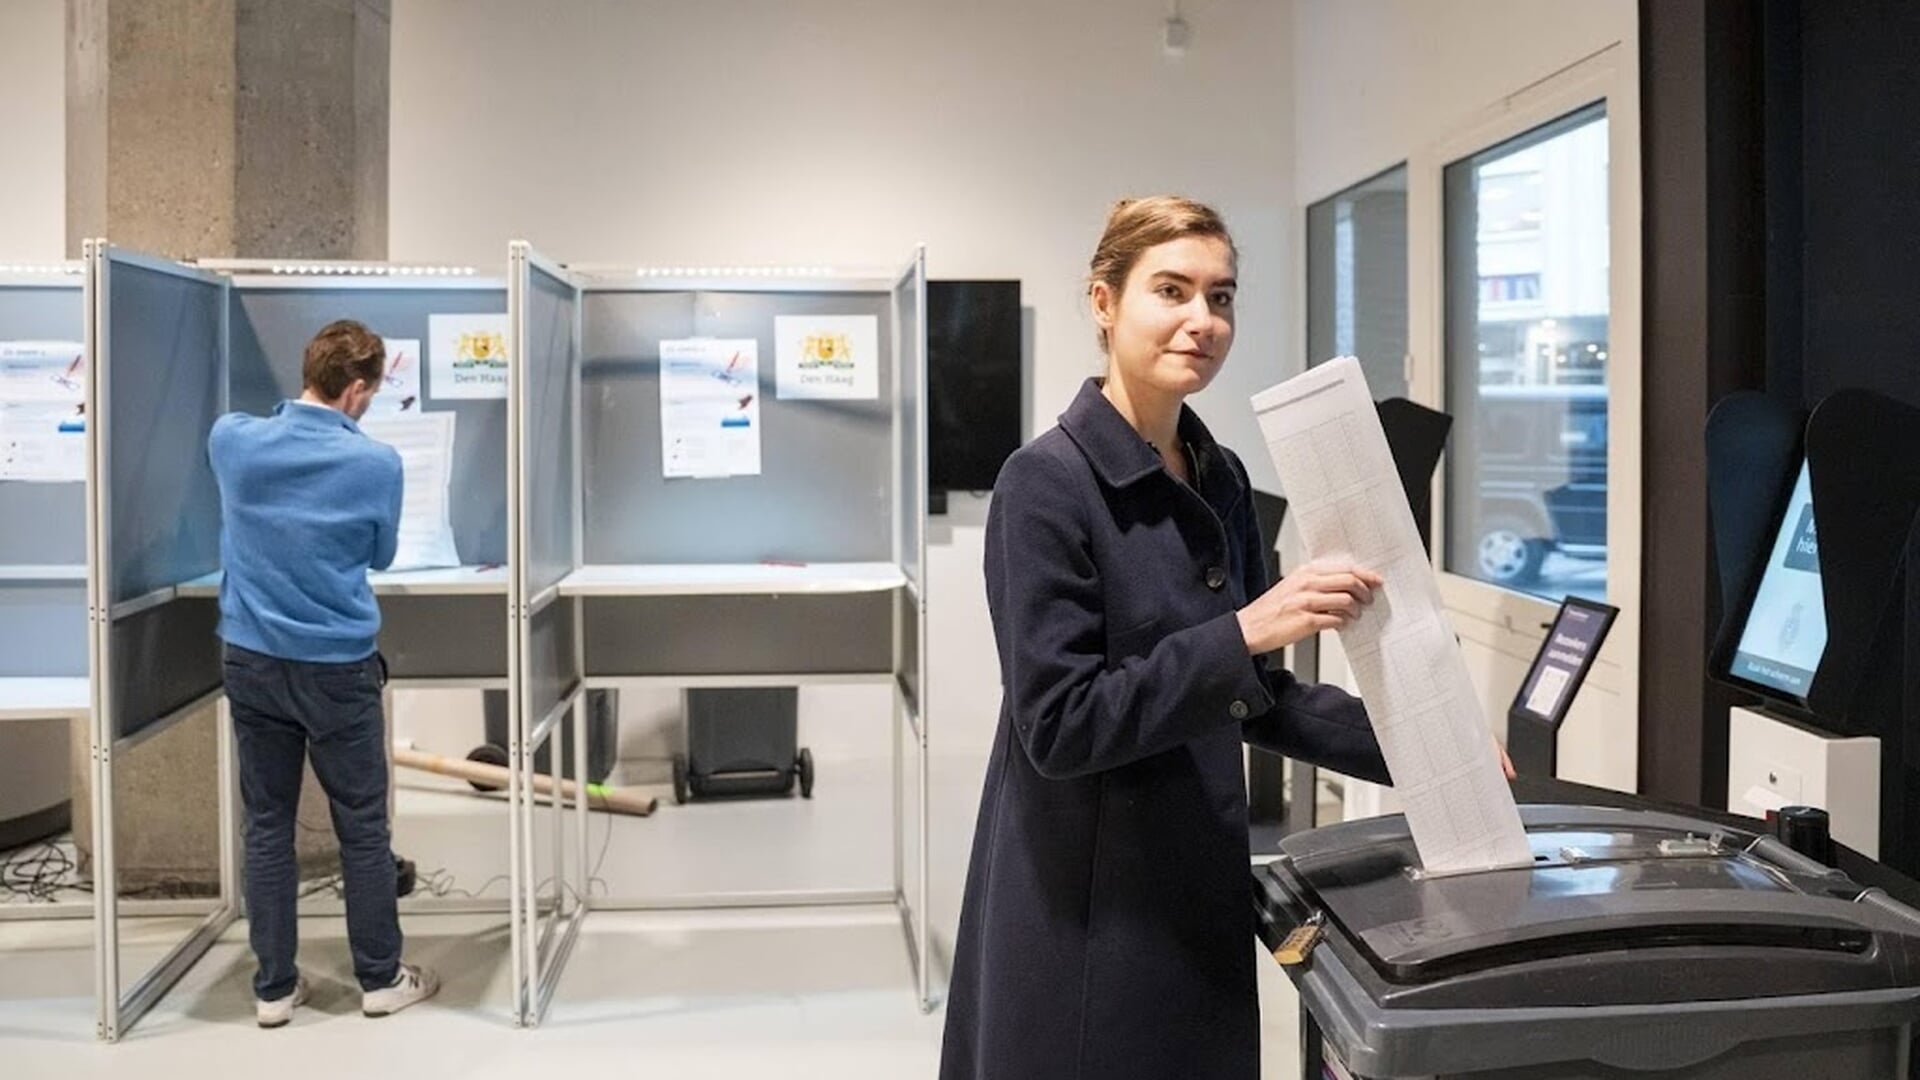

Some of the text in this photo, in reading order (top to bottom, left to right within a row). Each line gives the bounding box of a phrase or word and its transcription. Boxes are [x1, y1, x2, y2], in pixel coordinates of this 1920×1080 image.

[454, 374, 477, 384] Den
[800, 374, 854, 387] Den Haag
